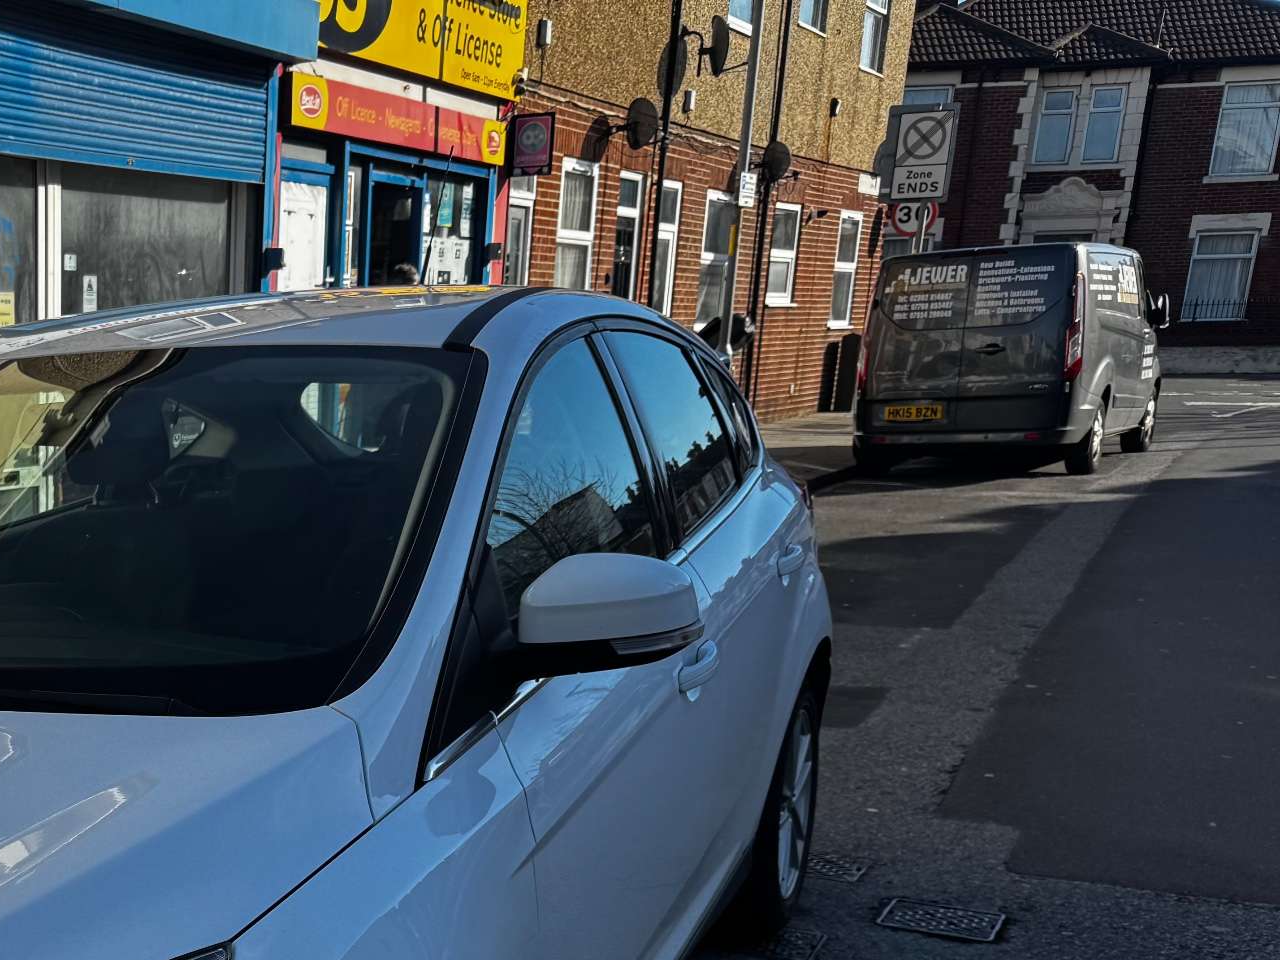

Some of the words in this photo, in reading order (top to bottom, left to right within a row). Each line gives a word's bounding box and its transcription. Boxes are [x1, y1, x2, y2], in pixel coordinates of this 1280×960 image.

[417, 8, 427, 44] &
[455, 22, 503, 68] License
[906, 170, 933, 180] Zone
[897, 181, 939, 194] ENDS
[910, 264, 968, 285] JEWER
[887, 407, 912, 419] HK15
[916, 406, 938, 418] BZN
